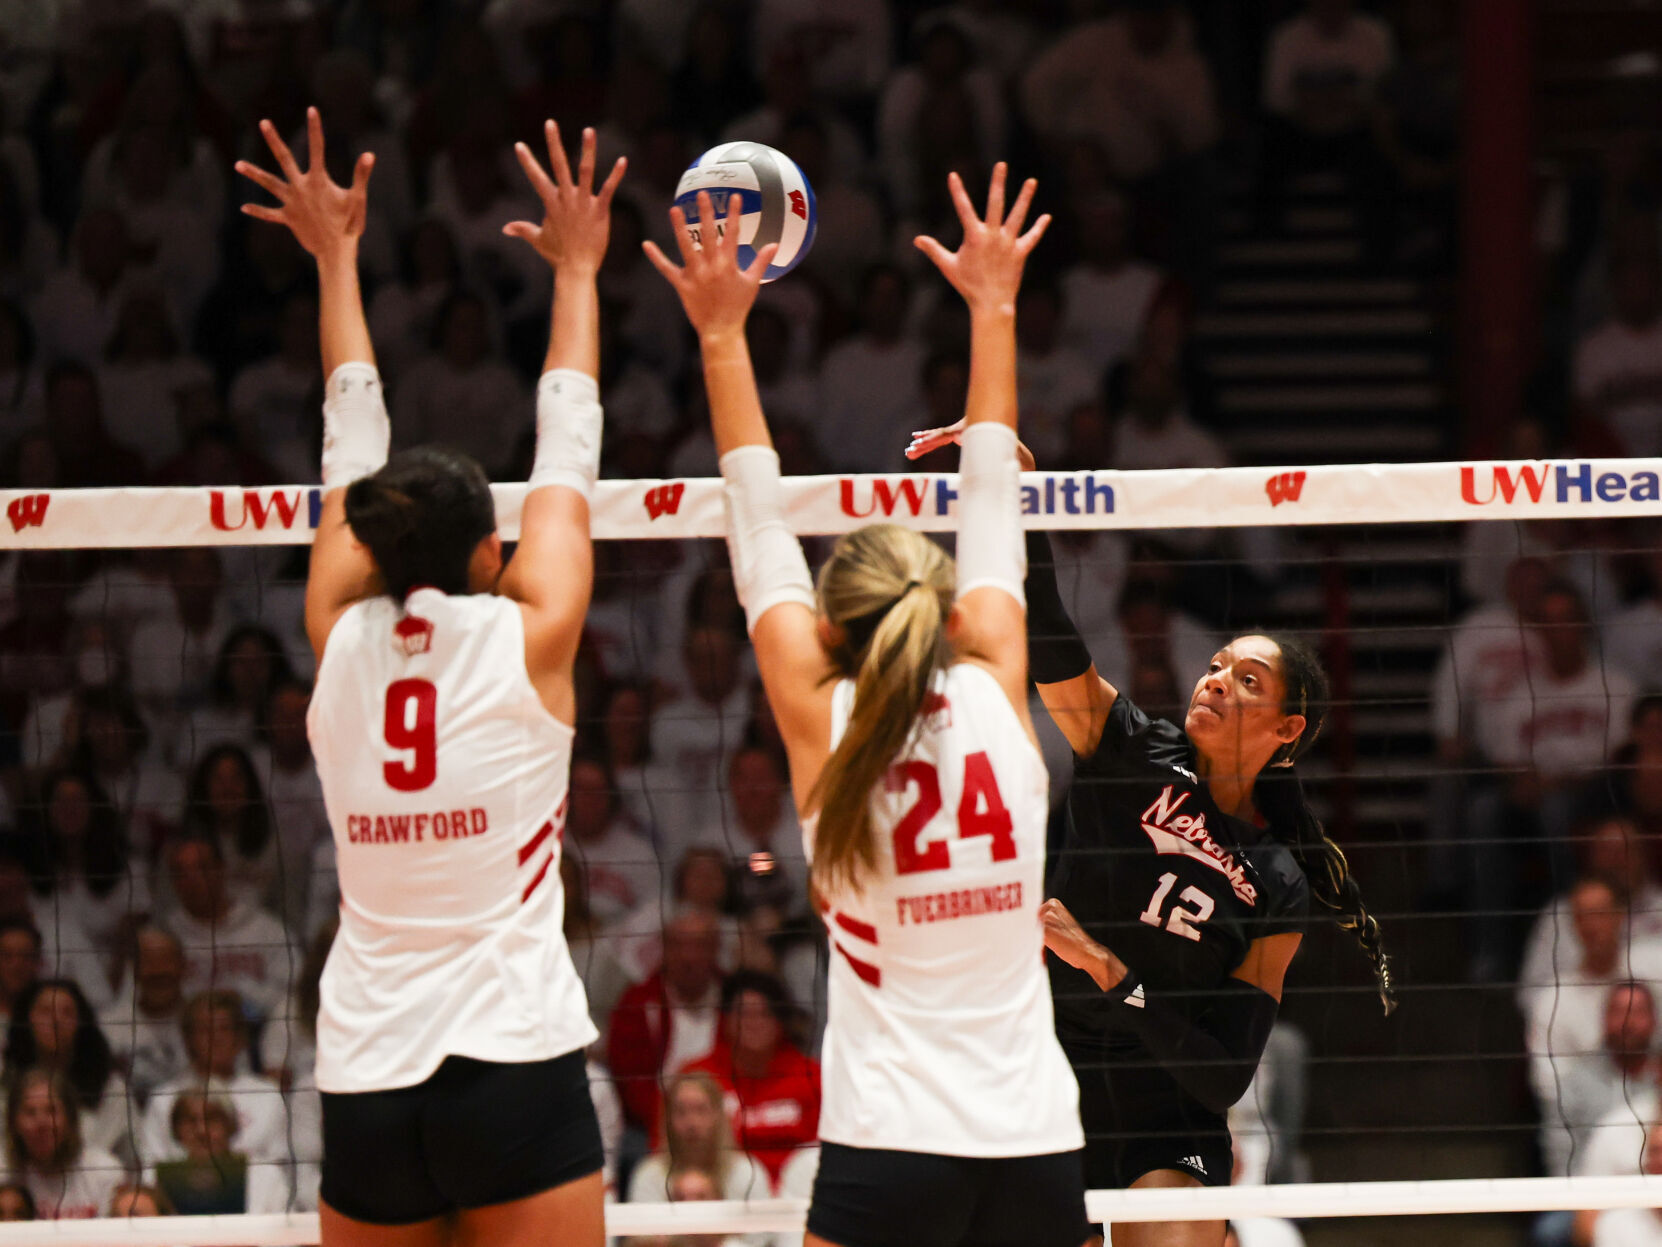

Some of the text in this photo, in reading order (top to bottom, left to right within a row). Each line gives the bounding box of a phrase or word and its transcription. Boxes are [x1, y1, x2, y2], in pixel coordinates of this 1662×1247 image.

[383, 678, 437, 792] 9
[347, 806, 489, 844] CRAWFORD
[885, 750, 1018, 875] 24
[896, 881, 1023, 926] FUERBRINGER
[1139, 872, 1216, 943] 12
